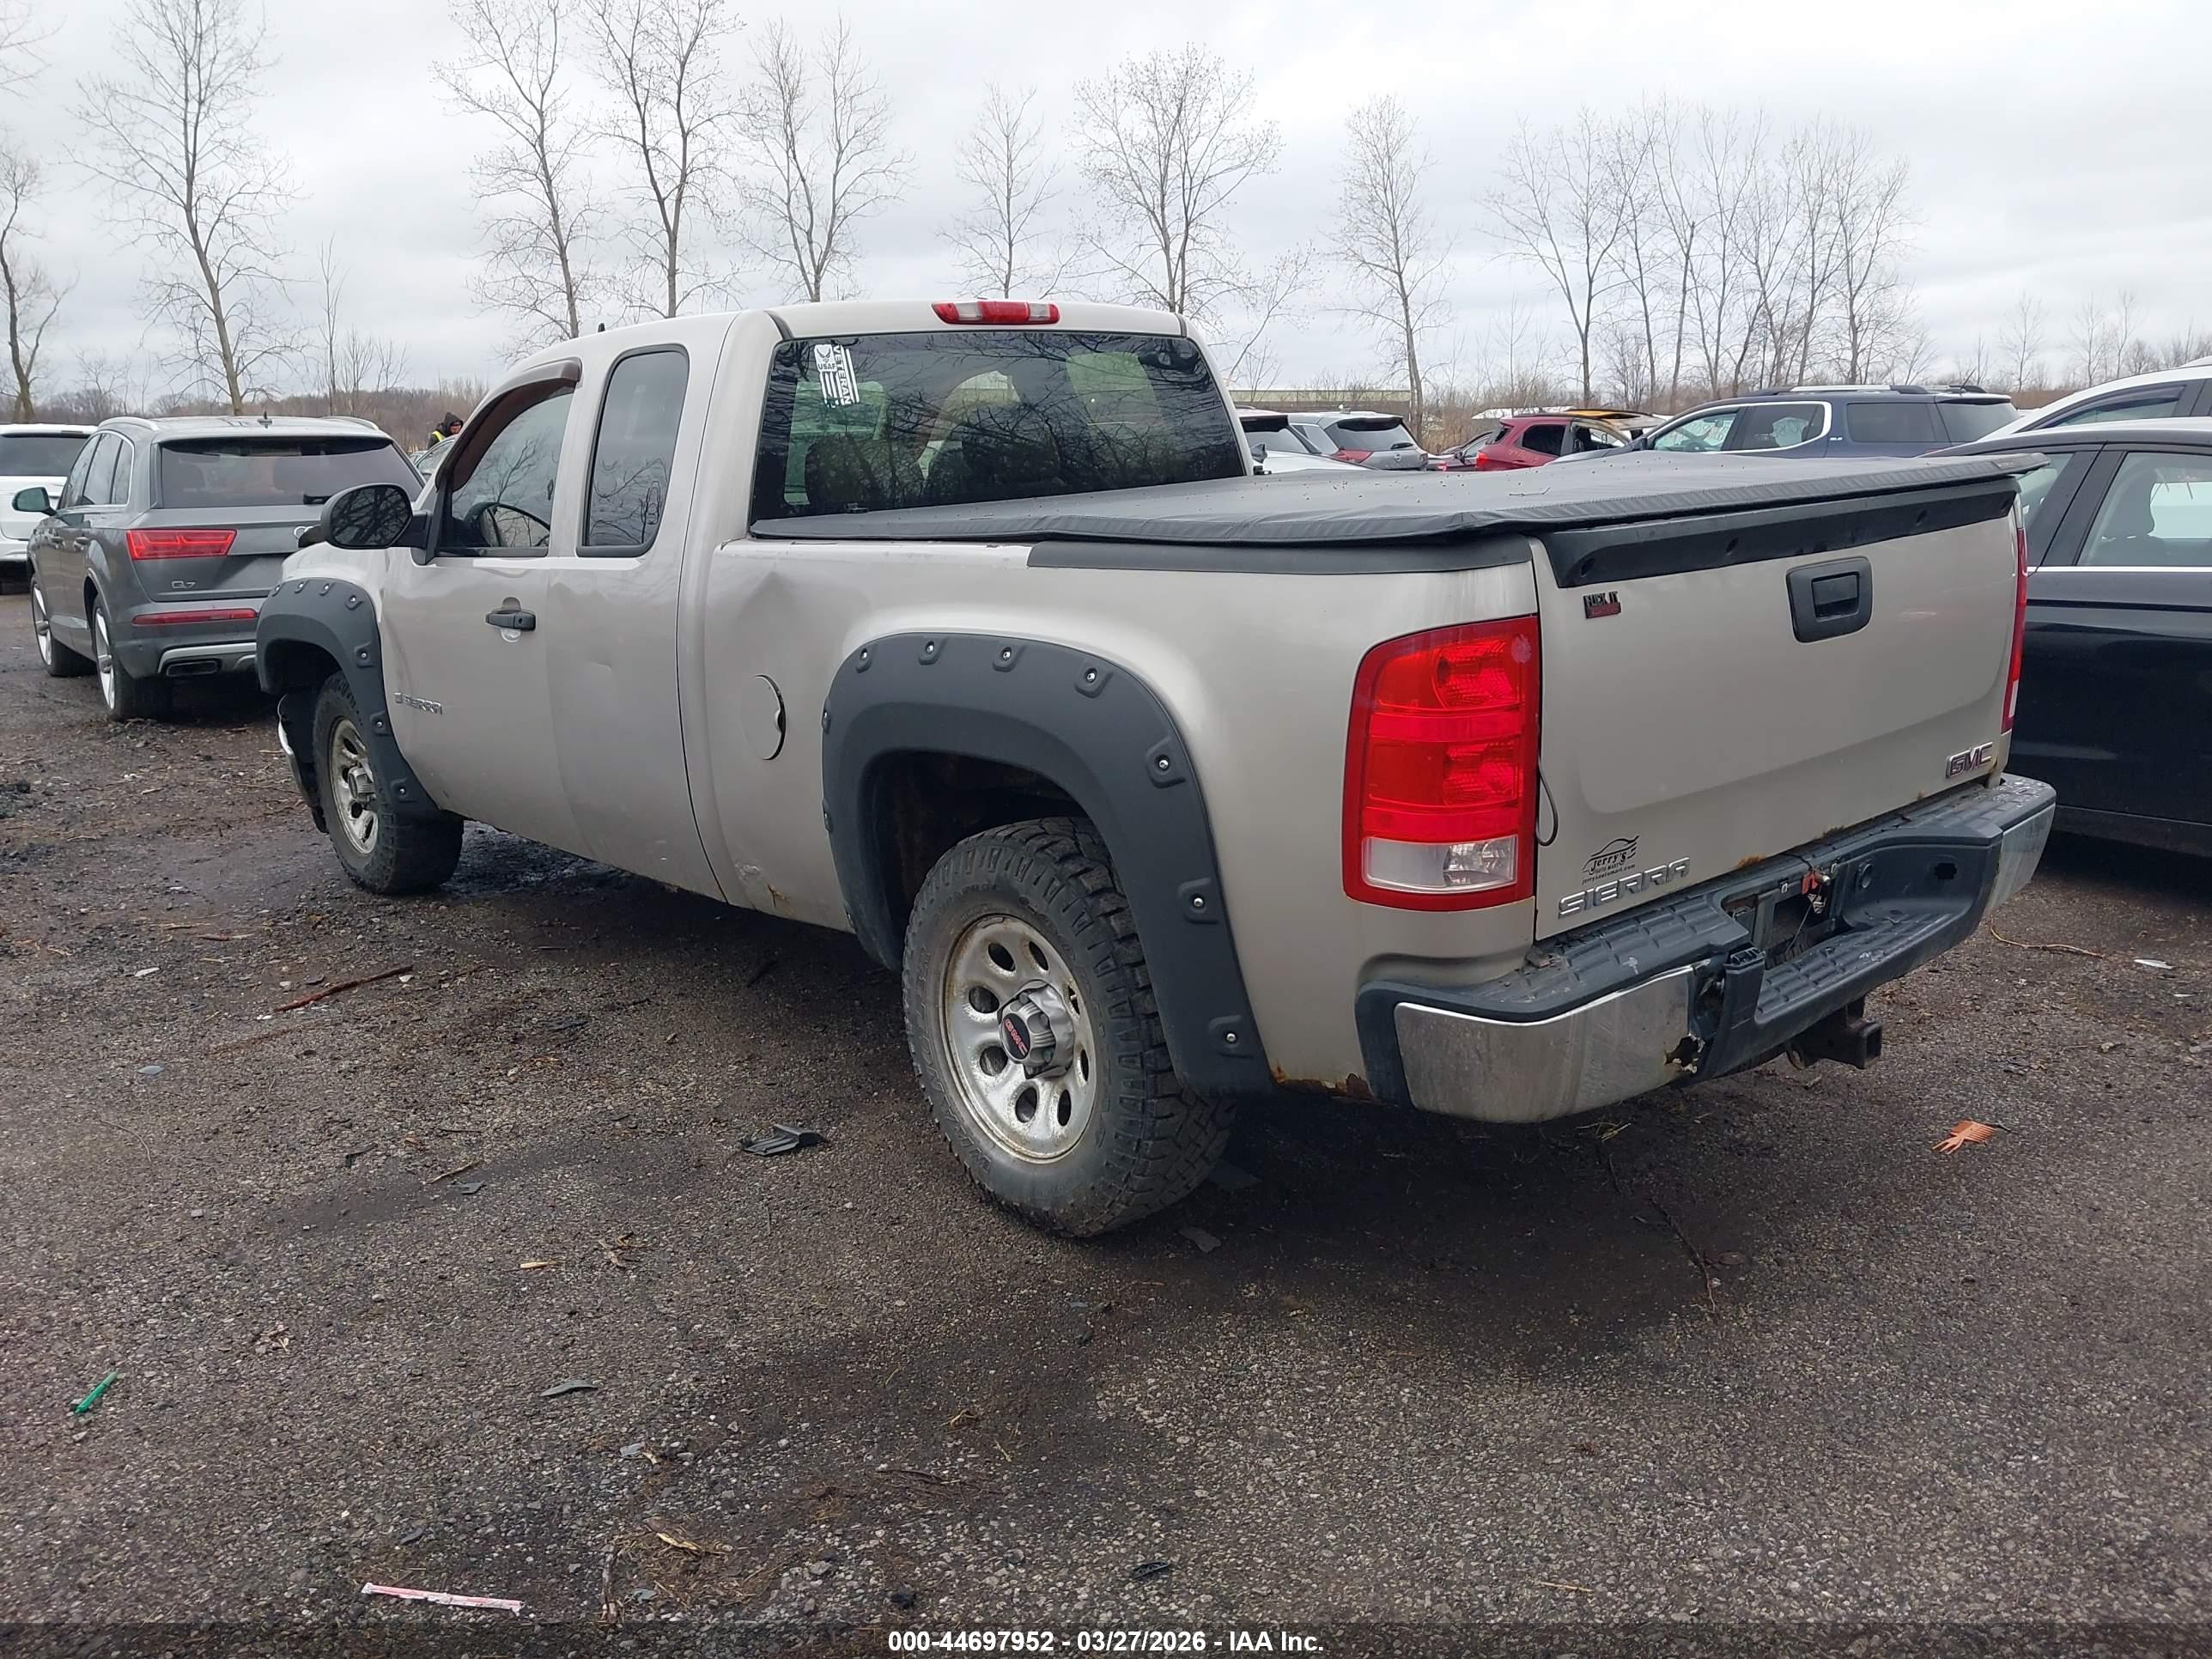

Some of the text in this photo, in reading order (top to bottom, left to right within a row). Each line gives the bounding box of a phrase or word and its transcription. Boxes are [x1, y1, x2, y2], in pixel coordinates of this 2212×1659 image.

[817, 362, 837, 371] USAF
[833, 344, 851, 405] VETERAN
[172, 580, 196, 590] Q7
[1944, 741, 1994, 780] GMC
[1558, 856, 1691, 919] SIERRA
[1003, 1018, 1029, 1057] GMC
